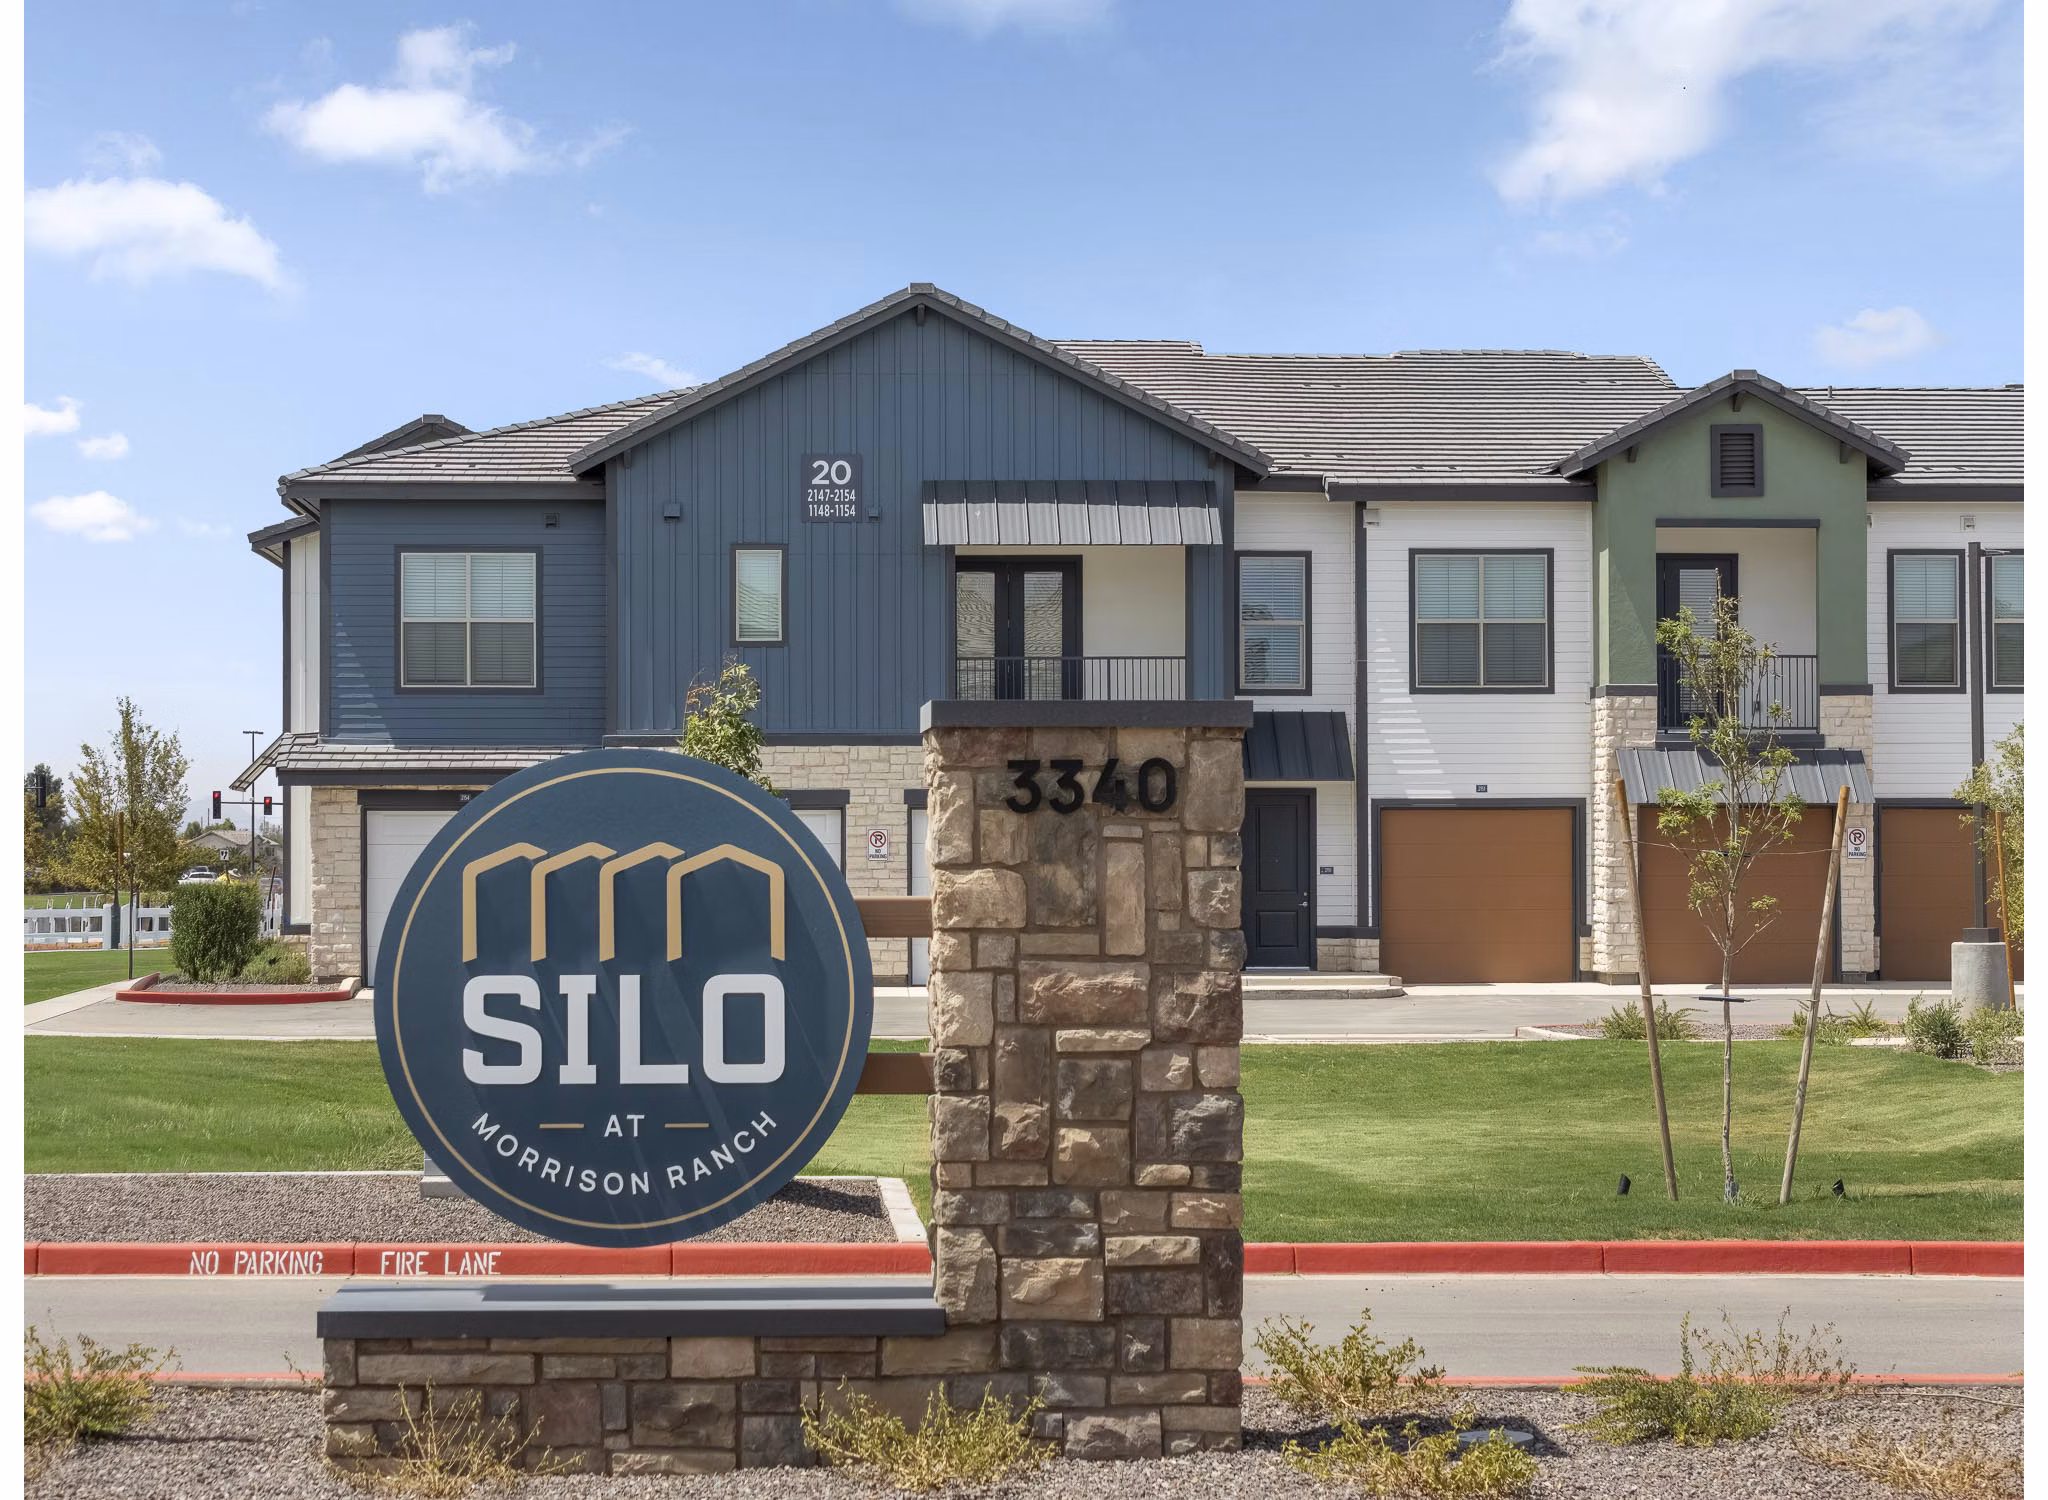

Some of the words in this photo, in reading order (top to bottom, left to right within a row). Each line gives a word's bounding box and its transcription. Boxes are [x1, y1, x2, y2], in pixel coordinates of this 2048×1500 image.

[811, 460, 852, 485] 20
[807, 489, 856, 502] 2147-2154
[808, 504, 856, 517] 1148-1154
[1006, 757, 1177, 814] 3340
[463, 973, 786, 1085] SILO
[604, 1114, 645, 1137] AT
[471, 1112, 650, 1195] MORRISON
[667, 1111, 777, 1189] RANCH
[189, 1251, 220, 1275] NO
[233, 1250, 324, 1275] PARKING
[380, 1251, 430, 1275] FIRE
[443, 1251, 502, 1275] LANE
